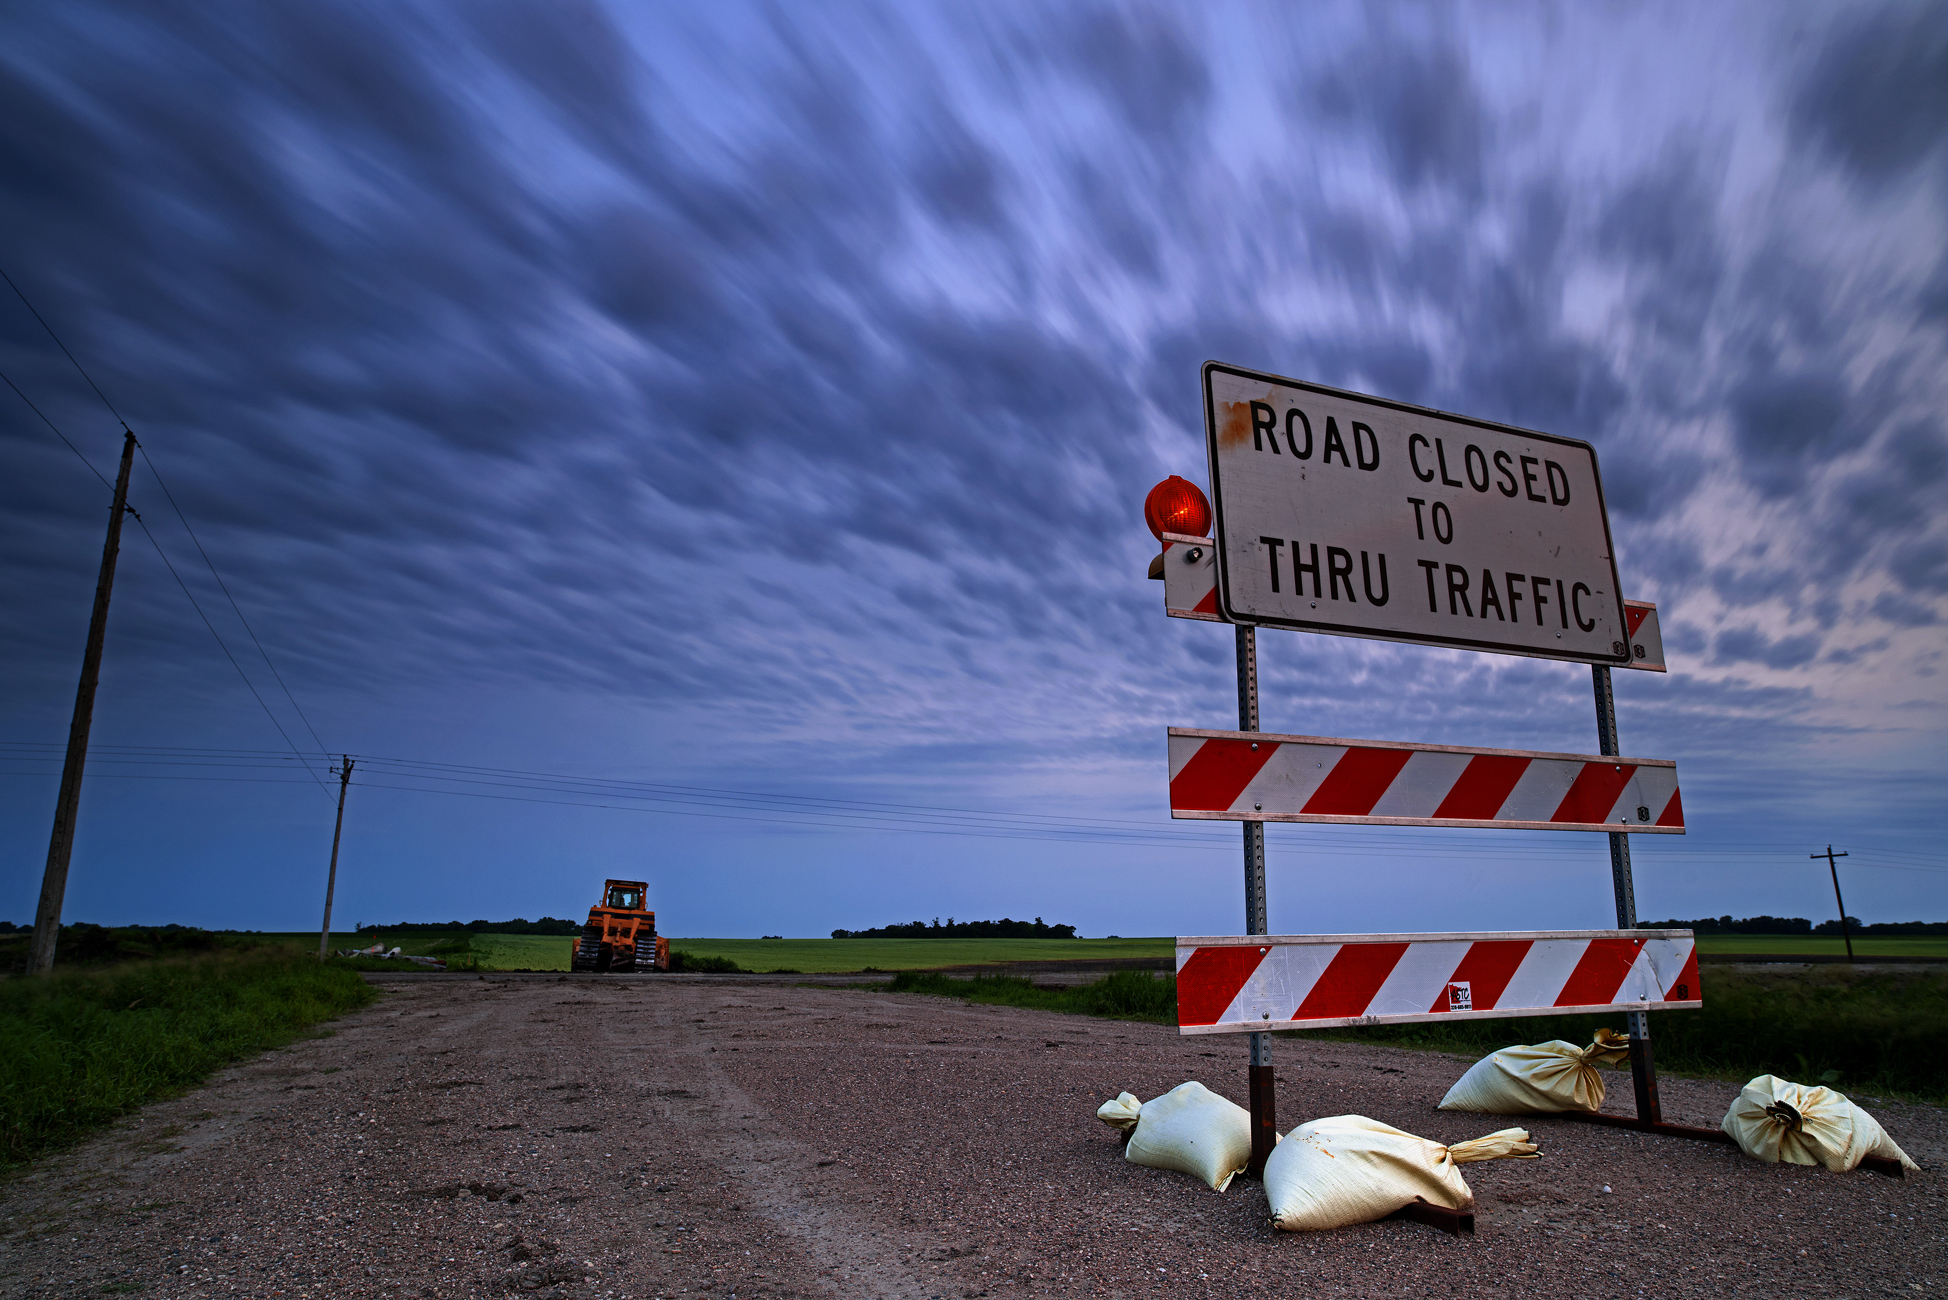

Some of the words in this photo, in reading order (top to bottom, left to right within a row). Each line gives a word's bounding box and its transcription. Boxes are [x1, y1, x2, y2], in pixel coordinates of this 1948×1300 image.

[1249, 400, 1380, 472] ROAD
[1408, 433, 1571, 507] CLOSED
[1407, 496, 1454, 545] TO
[1259, 535, 1390, 607] THRU
[1417, 558, 1596, 633] TRAFFIC
